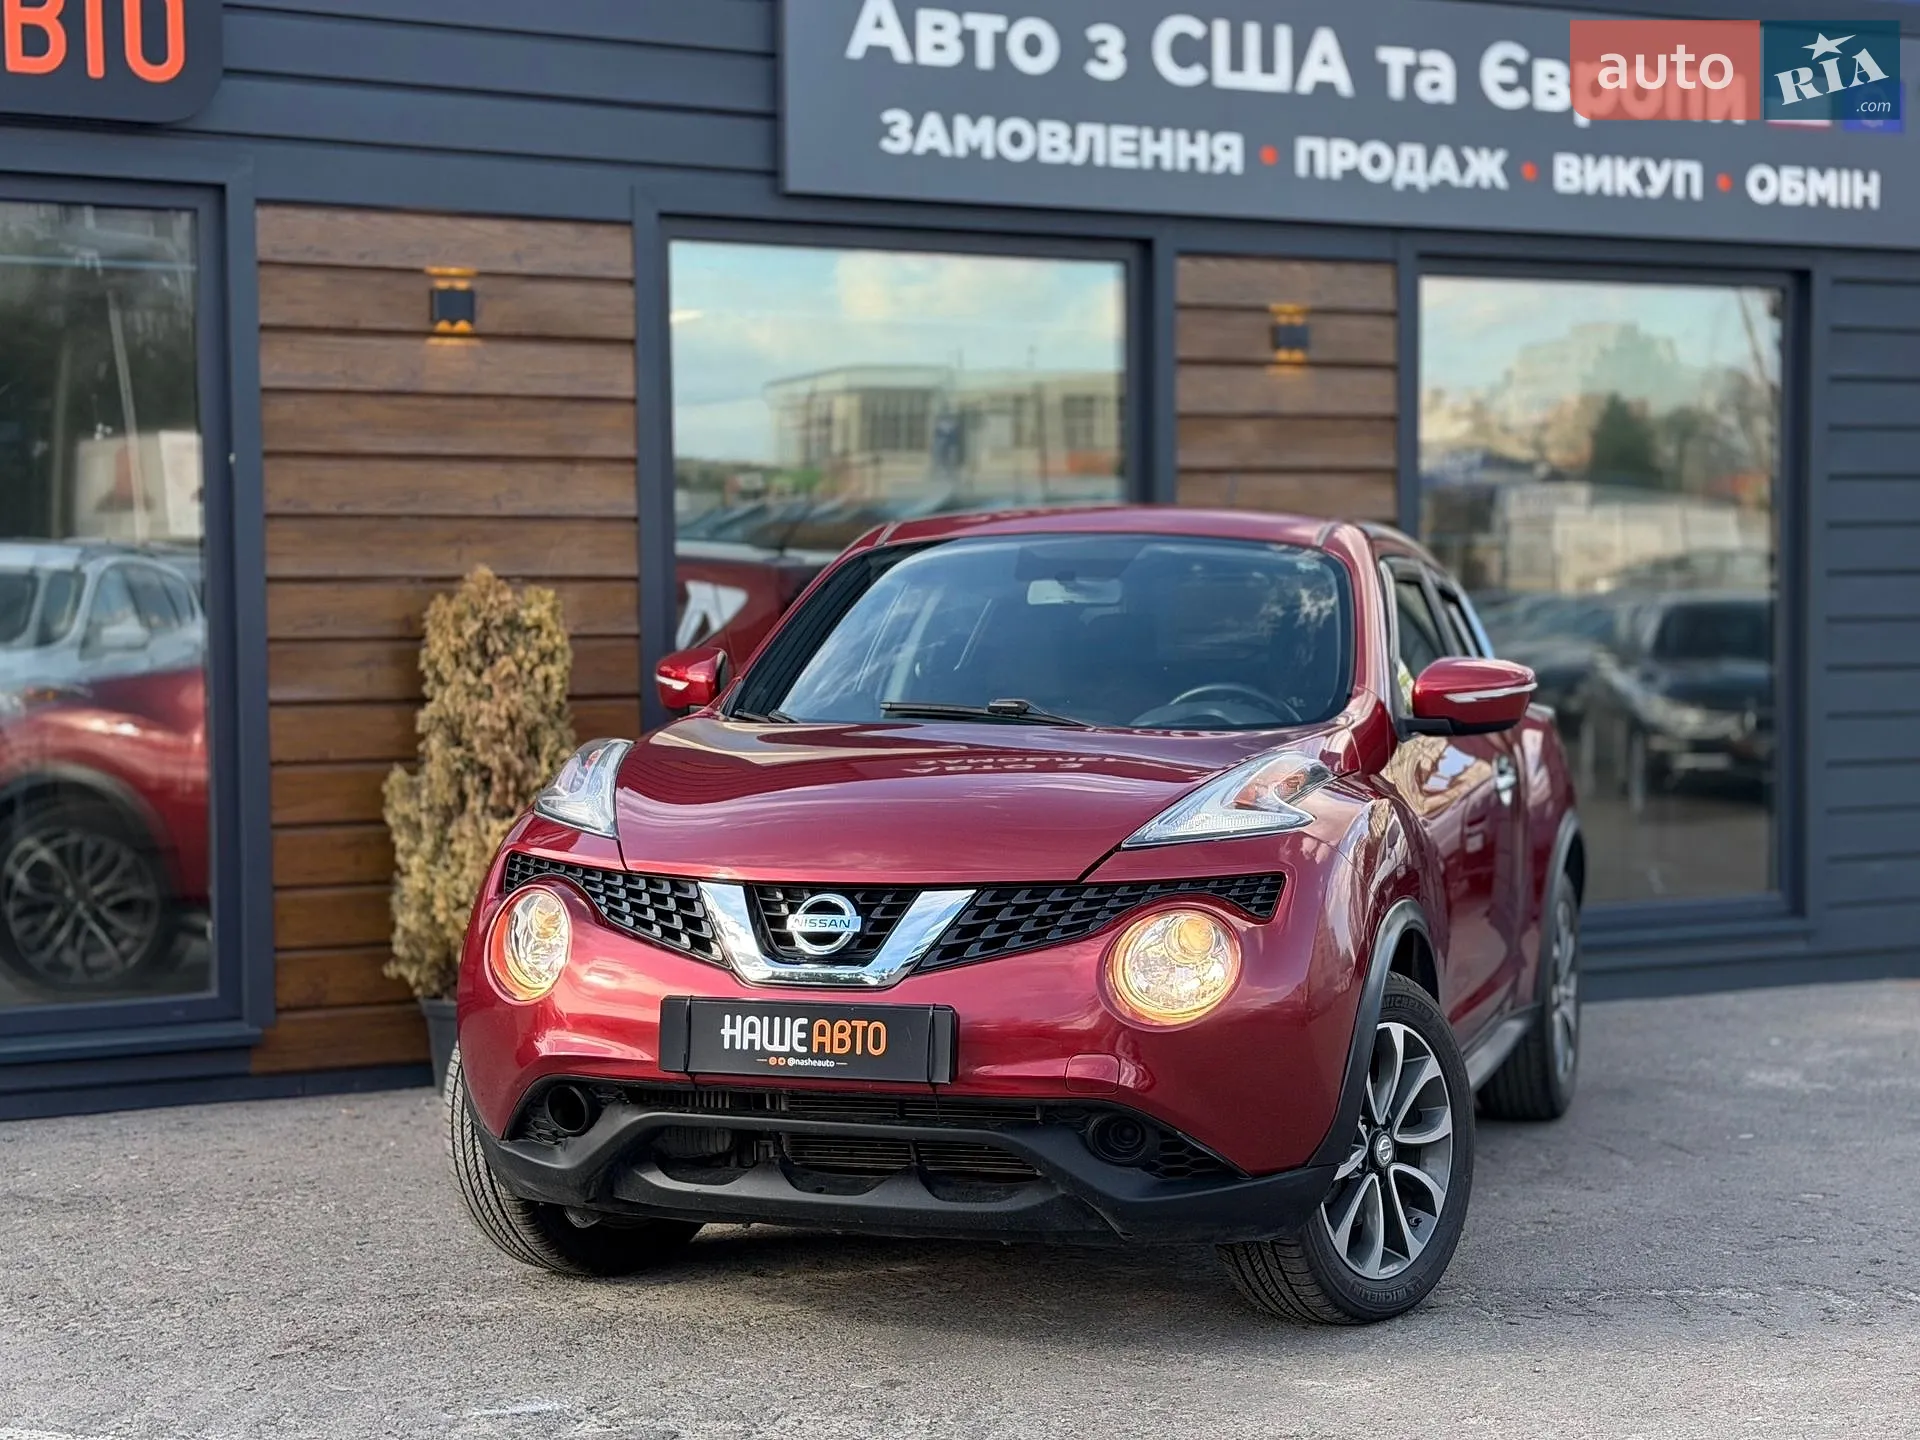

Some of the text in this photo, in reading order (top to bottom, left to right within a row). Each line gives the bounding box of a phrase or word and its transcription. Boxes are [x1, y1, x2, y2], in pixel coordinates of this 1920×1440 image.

[845, 0, 1060, 75] Авто
[1084, 23, 1128, 81] з
[1151, 15, 1355, 97] США
[1376, 45, 1457, 105] та
[879, 109, 1881, 209] ЗАМОВЛЕННЯ ПРОДАЖ ВИКУП ОБМІН
[794, 918, 851, 928] NISSAN
[720, 1014, 888, 1056] НАШЕ АВТО
[787, 1056, 835, 1068] @nasheauto
[1351, 1284, 1407, 1303] MICHELIN
